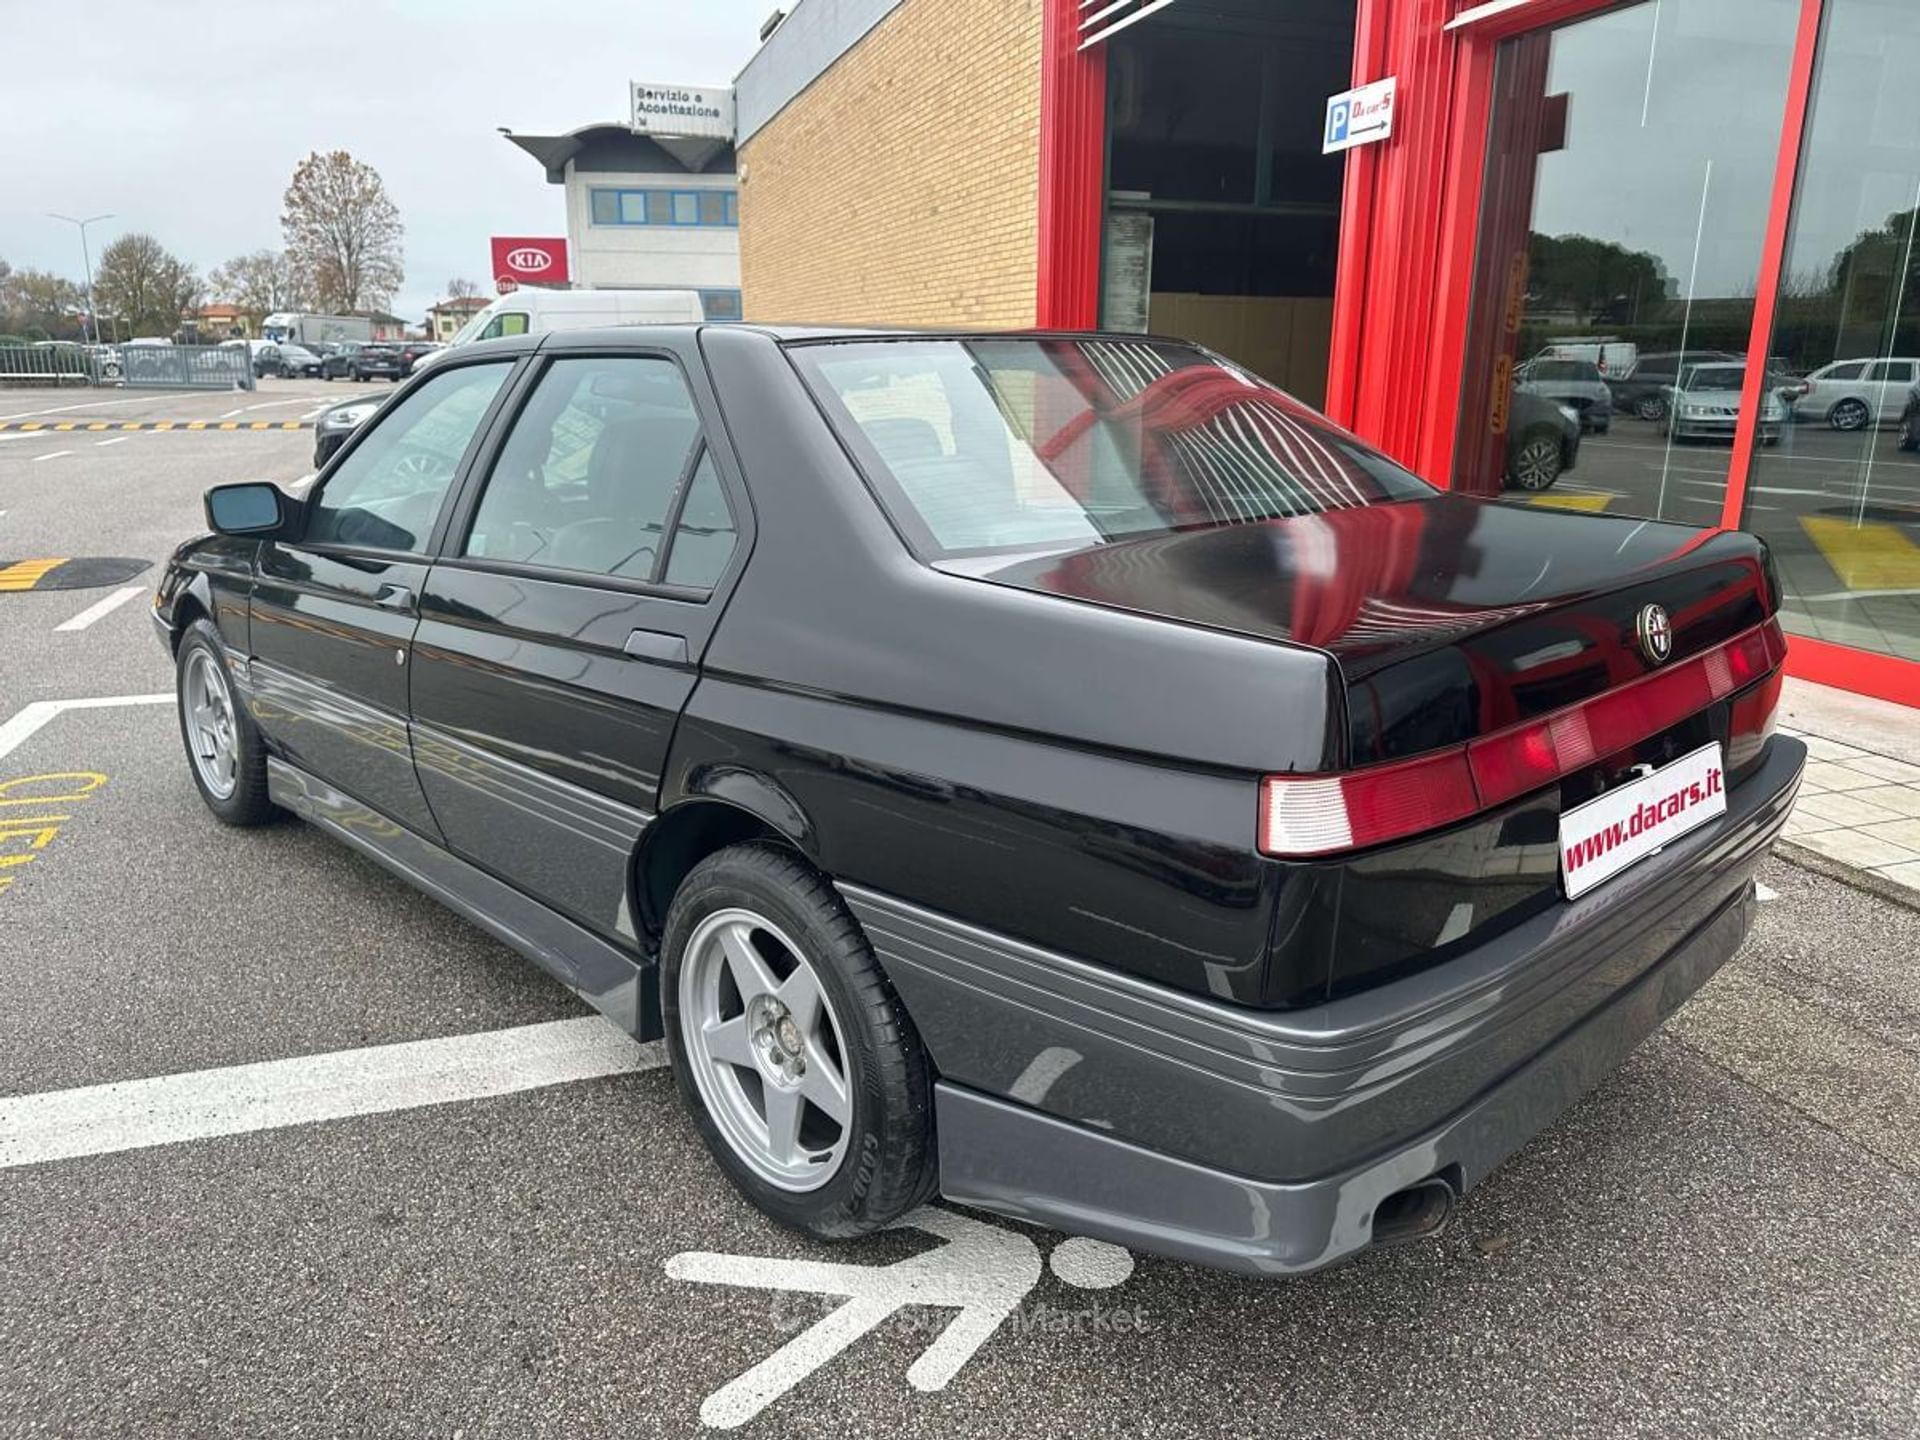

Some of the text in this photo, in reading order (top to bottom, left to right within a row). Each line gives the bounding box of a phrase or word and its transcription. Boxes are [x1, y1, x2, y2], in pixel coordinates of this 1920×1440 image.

[636, 88, 690, 103] Servizio
[637, 102, 720, 118] Accettazione
[1331, 105, 1346, 141] P
[515, 254, 545, 267] KIA
[1565, 768, 1723, 873] www.dacars.it
